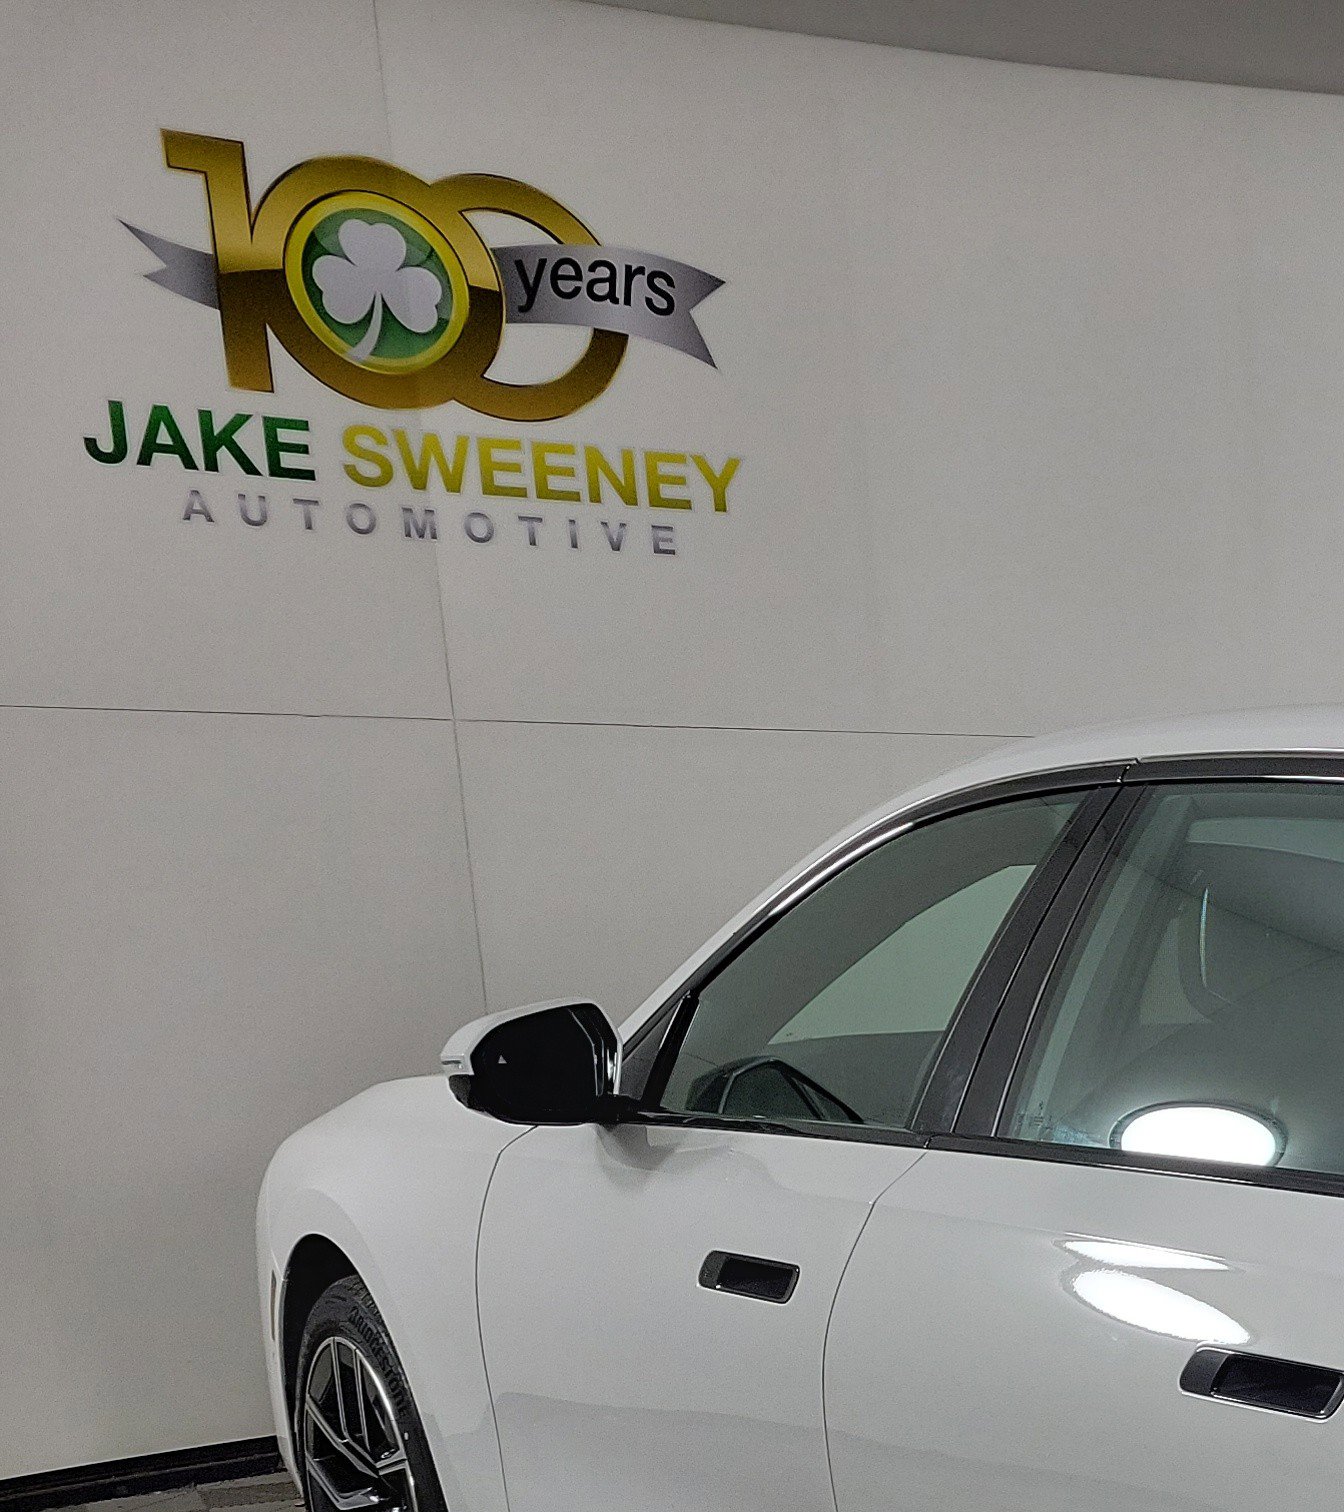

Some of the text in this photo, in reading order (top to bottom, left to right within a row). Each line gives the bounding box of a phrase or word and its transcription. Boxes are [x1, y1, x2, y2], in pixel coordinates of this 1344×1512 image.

[514, 255, 677, 317] years
[84, 399, 742, 514] JAKE SWEENEY
[182, 489, 677, 556] AUTOMOTIVE
